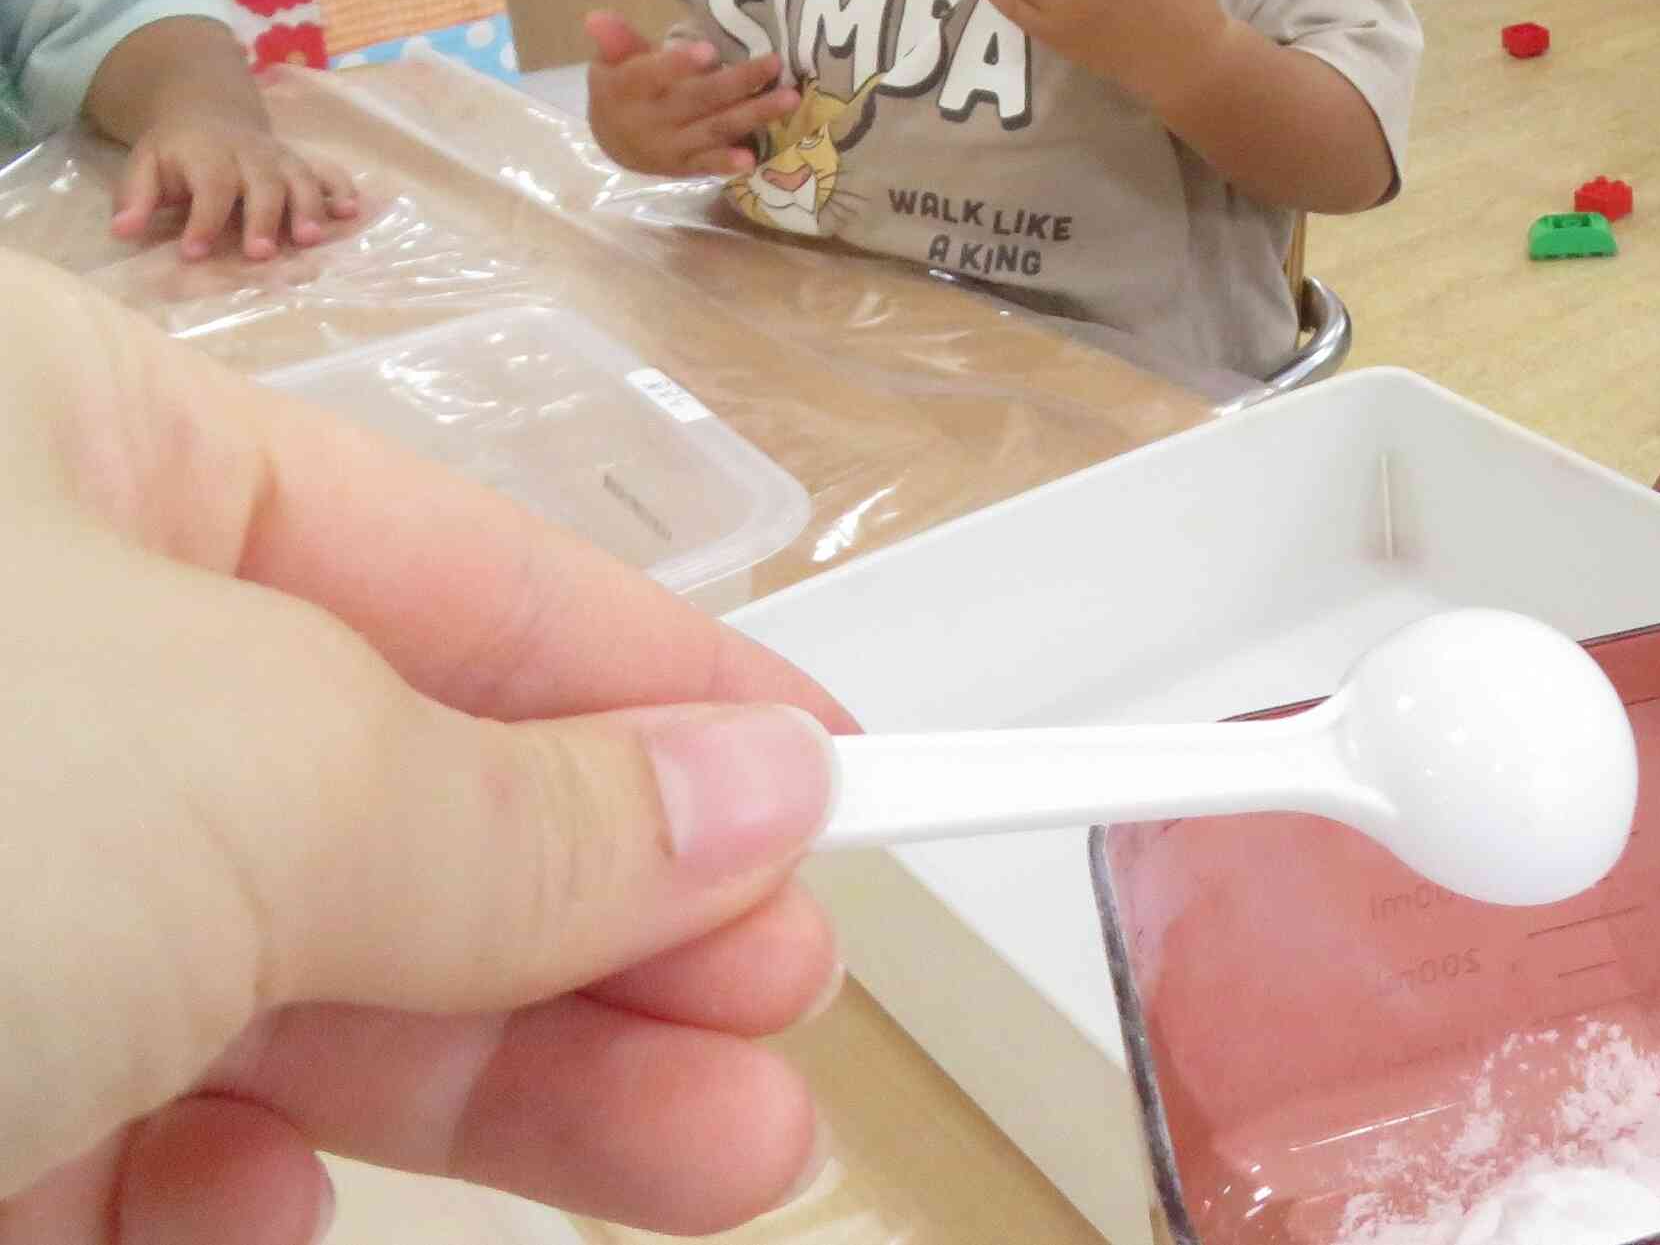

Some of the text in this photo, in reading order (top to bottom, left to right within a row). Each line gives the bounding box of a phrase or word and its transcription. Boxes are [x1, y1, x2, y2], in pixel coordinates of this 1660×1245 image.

[888, 188, 1073, 241] WALK LIKE
[928, 234, 1041, 276] A KING
